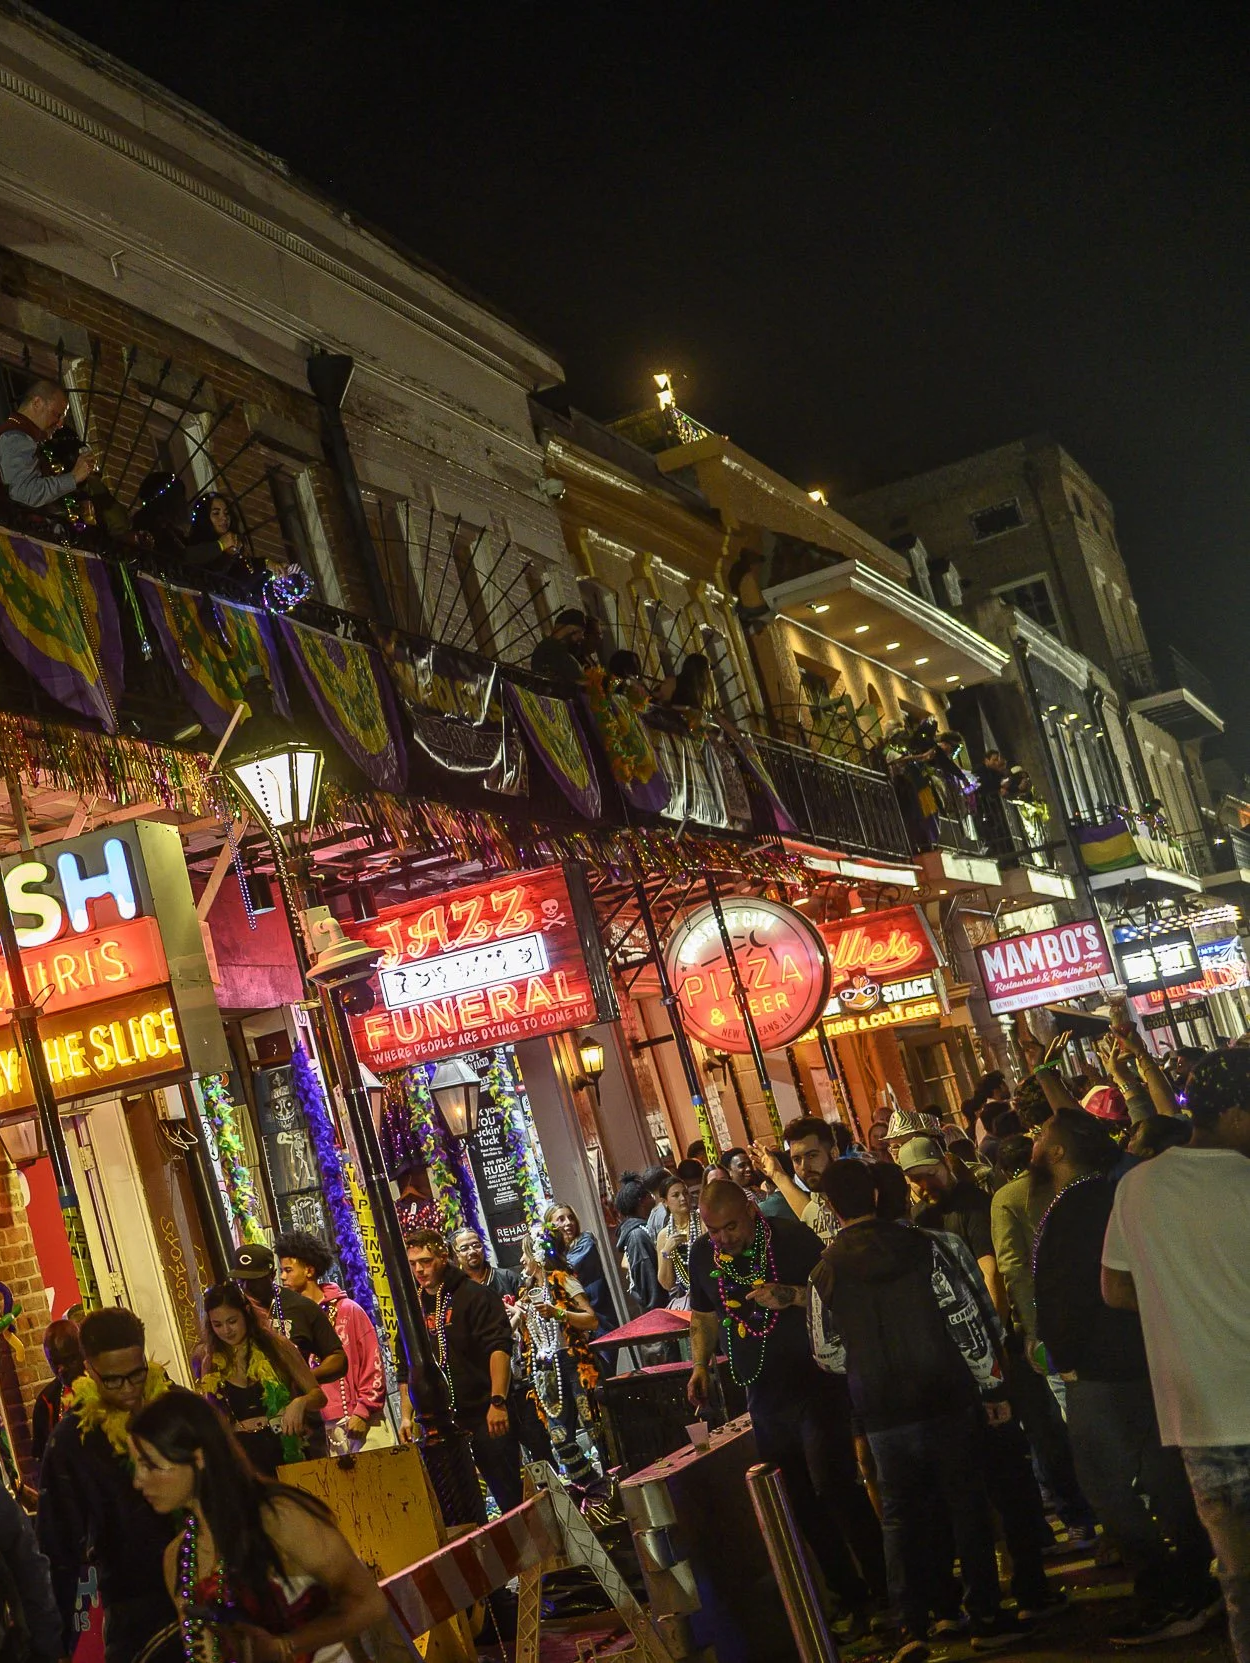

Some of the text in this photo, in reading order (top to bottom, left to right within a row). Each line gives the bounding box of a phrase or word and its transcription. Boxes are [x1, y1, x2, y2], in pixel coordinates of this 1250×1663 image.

[370, 884, 535, 969] JAZZ
[832, 926, 922, 976] llie's
[982, 924, 1100, 983] MAMBO'S
[683, 954, 804, 1008] PIZZA
[882, 977, 935, 1003] SHACK
[994, 961, 1103, 993] Restaurant & Rooftop Bar
[364, 970, 588, 1051] FUNERAL
[710, 1008, 727, 1026] &
[721, 1012, 793, 1039] NEW OEANS, LA
[859, 1017, 870, 1031] &
[904, 1001, 940, 1018] BEER
[42, 1031, 94, 1084] HE
[90, 1007, 181, 1071] SLICE
[414, 1037, 456, 1056] PEOPLE
[458, 1031, 479, 1046] ARE
[482, 1020, 520, 1041] DYING
[522, 1017, 539, 1031] TO
[540, 1009, 573, 1028] COME
[474, 1124, 502, 1138] uckin'
[479, 1135, 500, 1147] fuck
[497, 1223, 528, 1237] REHAB
